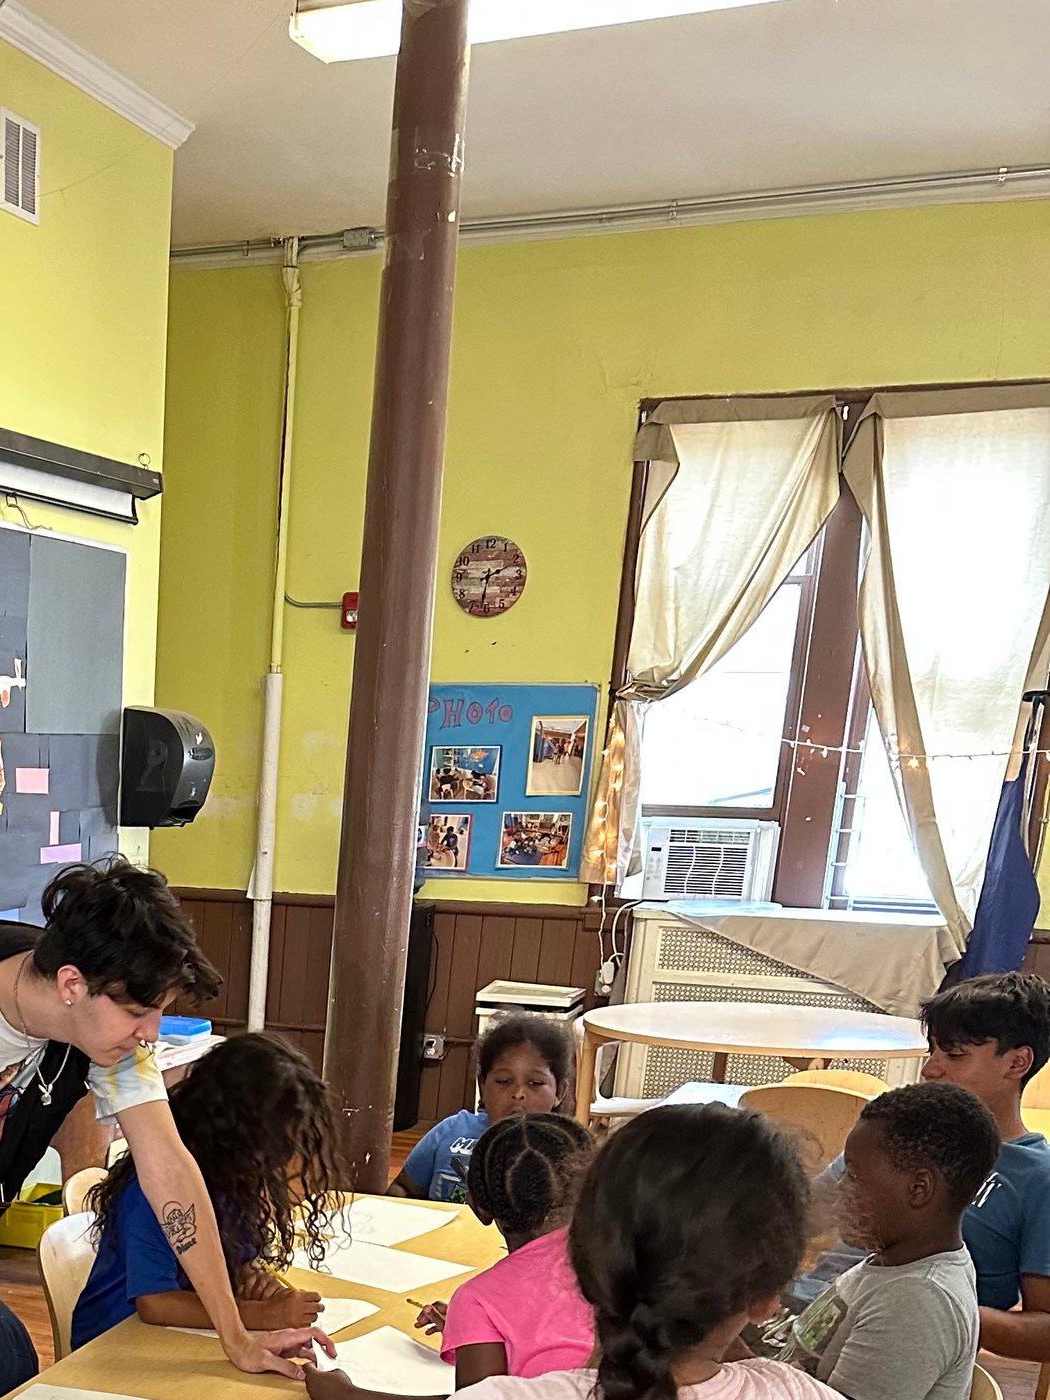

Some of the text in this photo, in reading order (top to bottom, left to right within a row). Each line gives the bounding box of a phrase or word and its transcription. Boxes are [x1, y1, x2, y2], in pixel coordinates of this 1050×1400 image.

[471, 544, 480, 553] 11
[485, 538, 496, 549] 12
[503, 541, 509, 552] 1
[458, 556, 470, 566] 10
[512, 553, 519, 564] 2
[455, 572, 463, 583] 9
[515, 569, 522, 579] 3
[458, 588, 466, 599] 8
[510, 586, 517, 597] 4
[468, 600, 475, 613] 7
[483, 603, 490, 614] 6
[498, 598, 505, 609] 5
